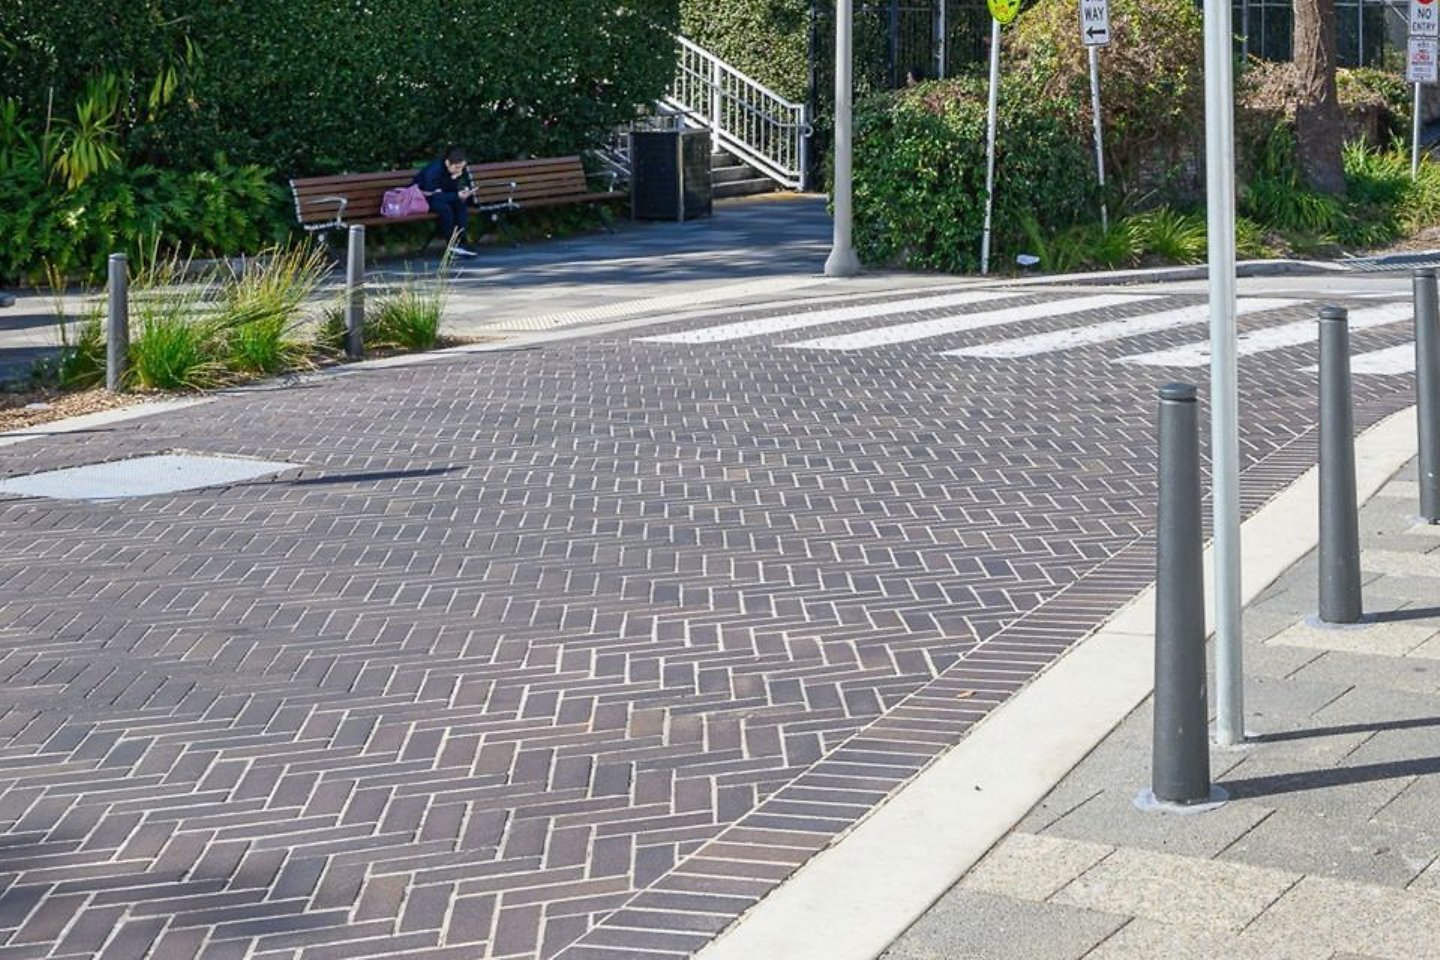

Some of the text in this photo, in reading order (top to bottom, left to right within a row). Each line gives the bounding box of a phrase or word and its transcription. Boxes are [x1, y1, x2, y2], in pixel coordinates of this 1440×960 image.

[1084, 7, 1105, 21] WAY
[1417, 8, 1432, 19] NO
[1412, 22, 1436, 31] ENTRY
